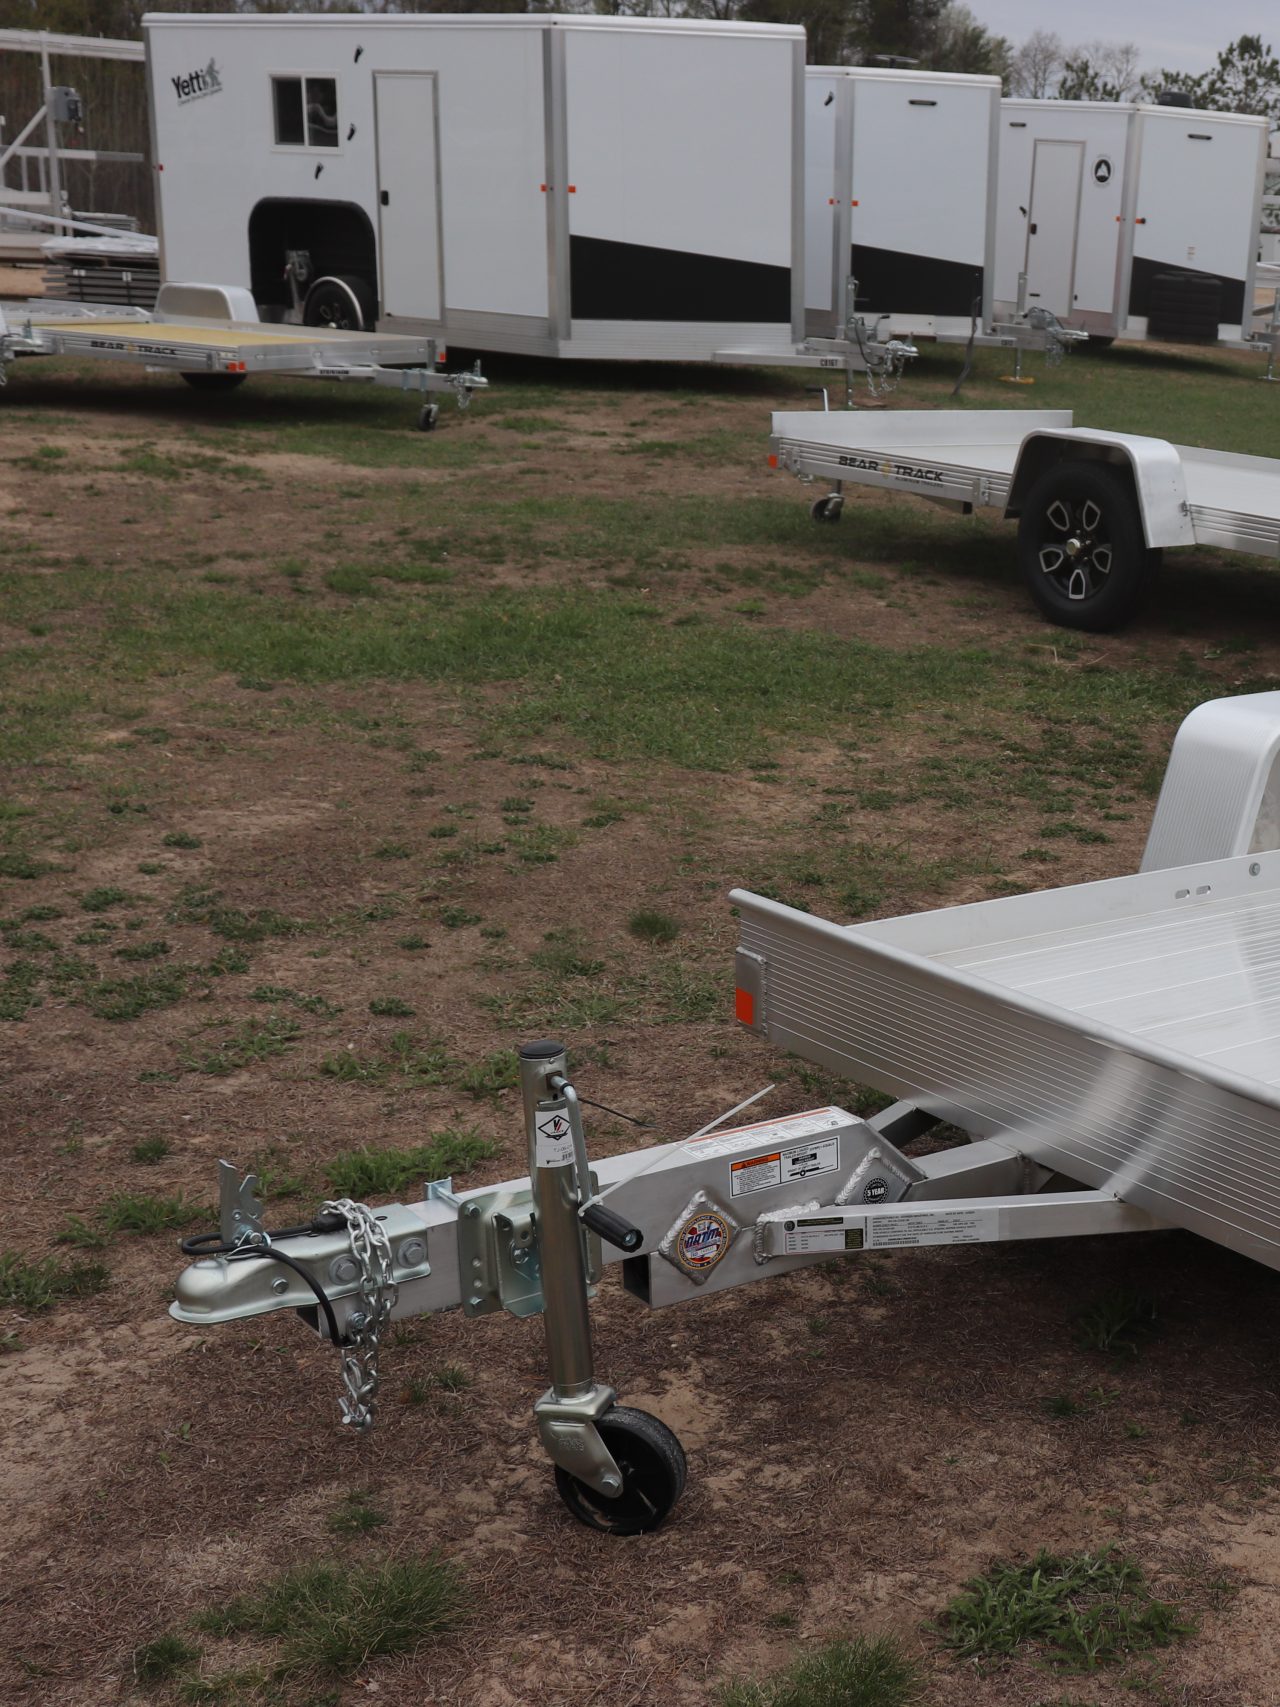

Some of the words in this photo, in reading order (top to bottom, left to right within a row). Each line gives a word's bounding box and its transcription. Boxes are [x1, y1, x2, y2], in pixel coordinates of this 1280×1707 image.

[171, 68, 206, 98] Yetti
[839, 455, 879, 471] BEAR
[894, 464, 944, 482] TRACK
[872, 1187, 885, 1196] YEAR
